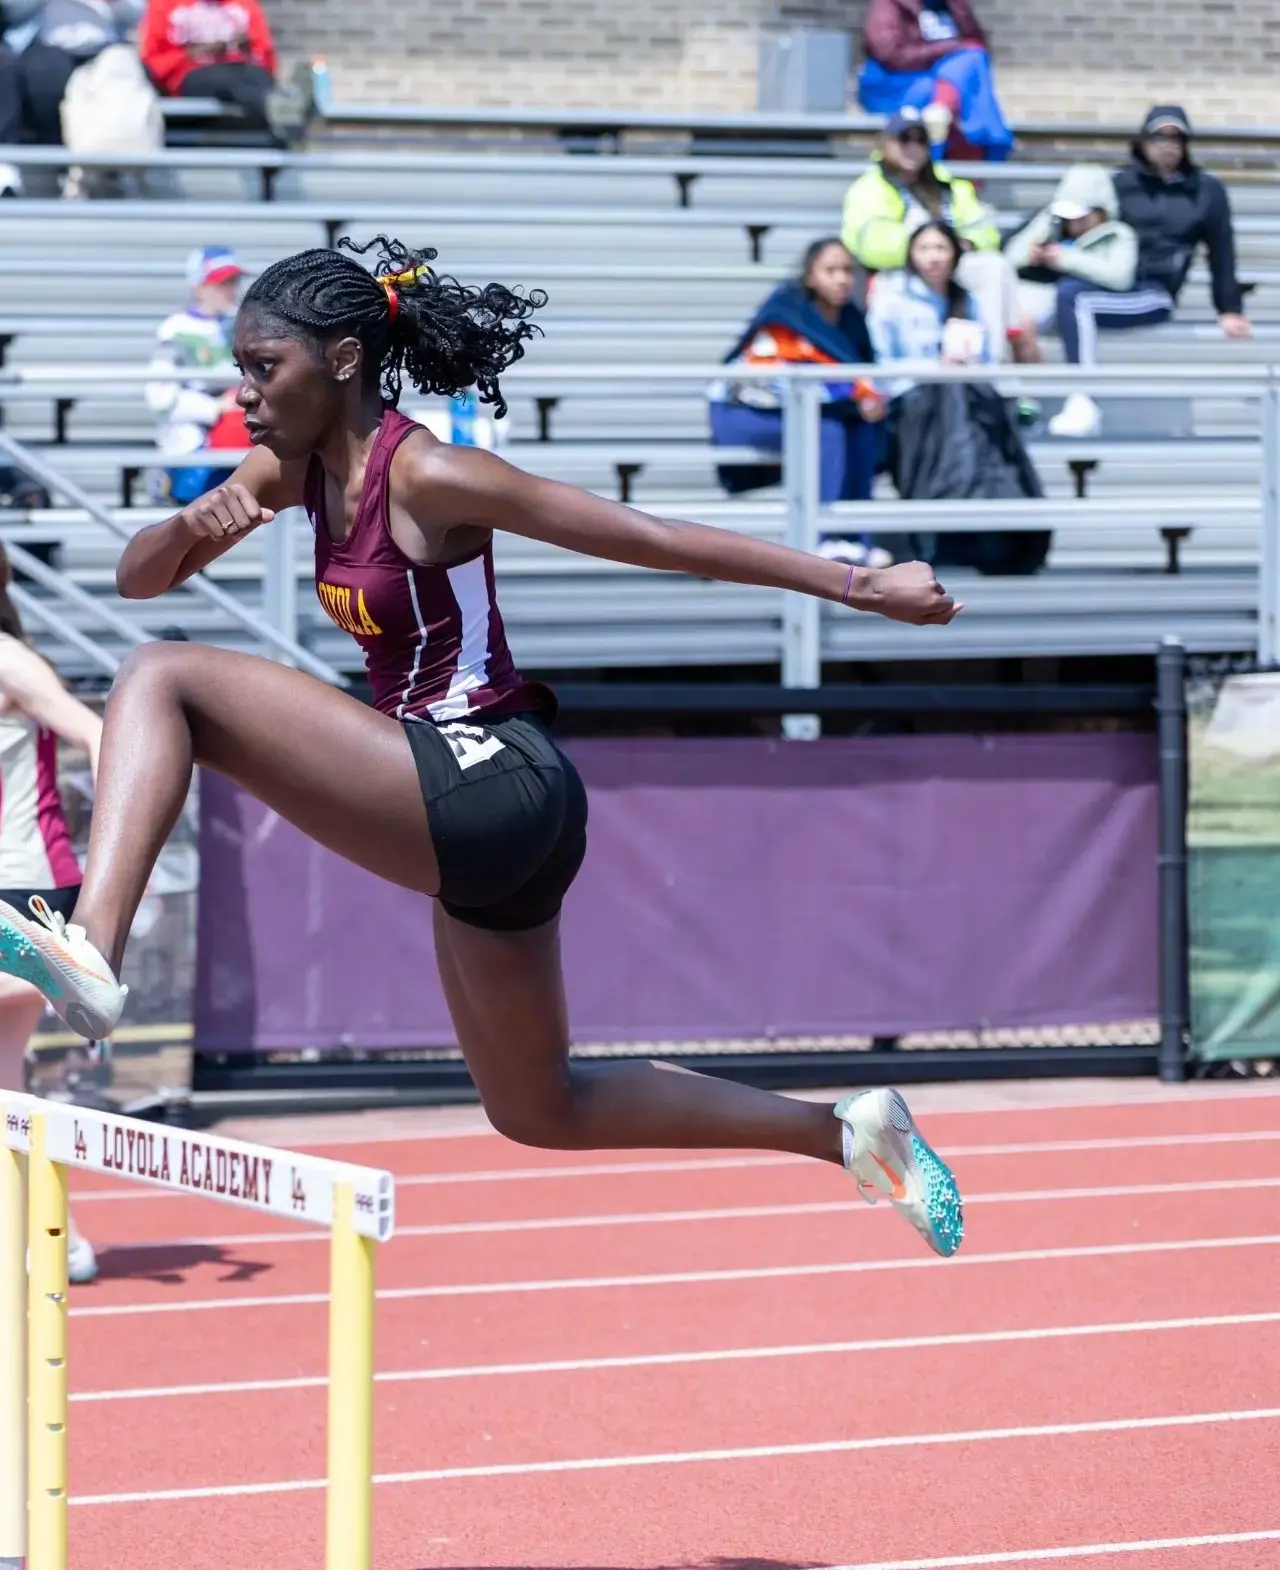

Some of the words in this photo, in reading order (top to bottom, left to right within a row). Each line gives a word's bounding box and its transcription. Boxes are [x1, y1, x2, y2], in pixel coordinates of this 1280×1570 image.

[74, 1119, 86, 1160] LA
[102, 1123, 170, 1181] LOYOLA
[180, 1140, 273, 1205] ACADEMY
[291, 1165, 306, 1212] LA
